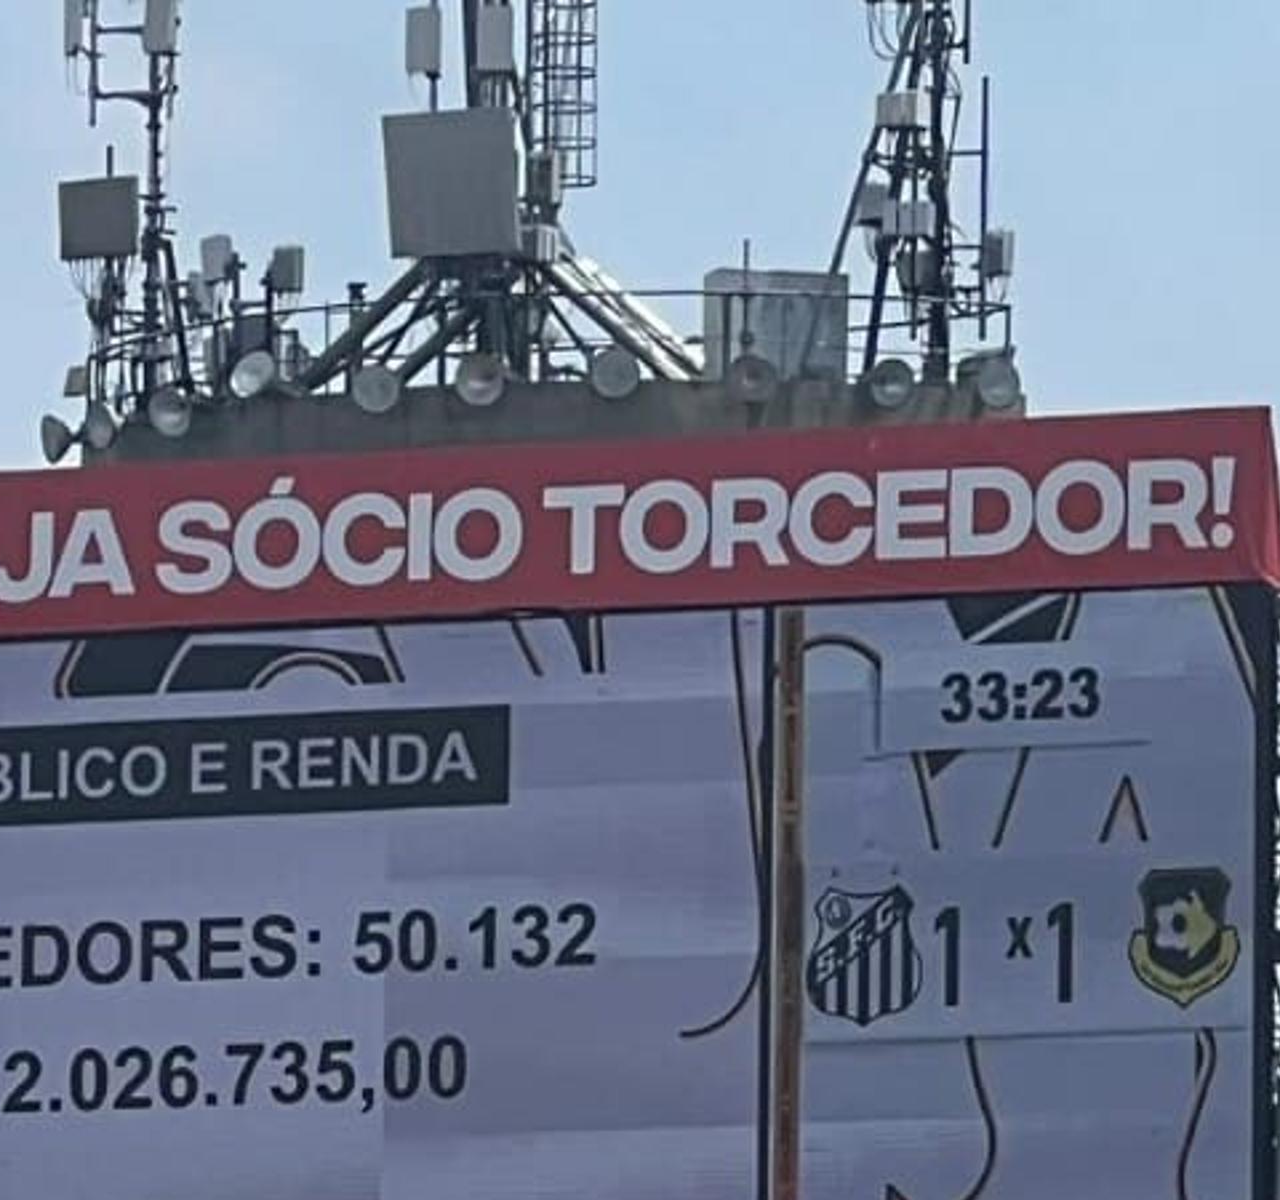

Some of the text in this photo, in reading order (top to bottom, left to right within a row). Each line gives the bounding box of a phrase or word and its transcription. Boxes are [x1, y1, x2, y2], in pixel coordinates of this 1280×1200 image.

[156, 477, 523, 595] SÓCIO
[543, 457, 1235, 577] TORCEDOR!
[939, 667, 1101, 724] 33:23
[191, 742, 227, 793] E
[251, 733, 477, 791] RENDA
[353, 903, 597, 974] 50.132
[934, 907, 961, 1007] 1
[1047, 902, 1074, 1003] 1
[2, 1034, 468, 1114] 2.026.735,00
